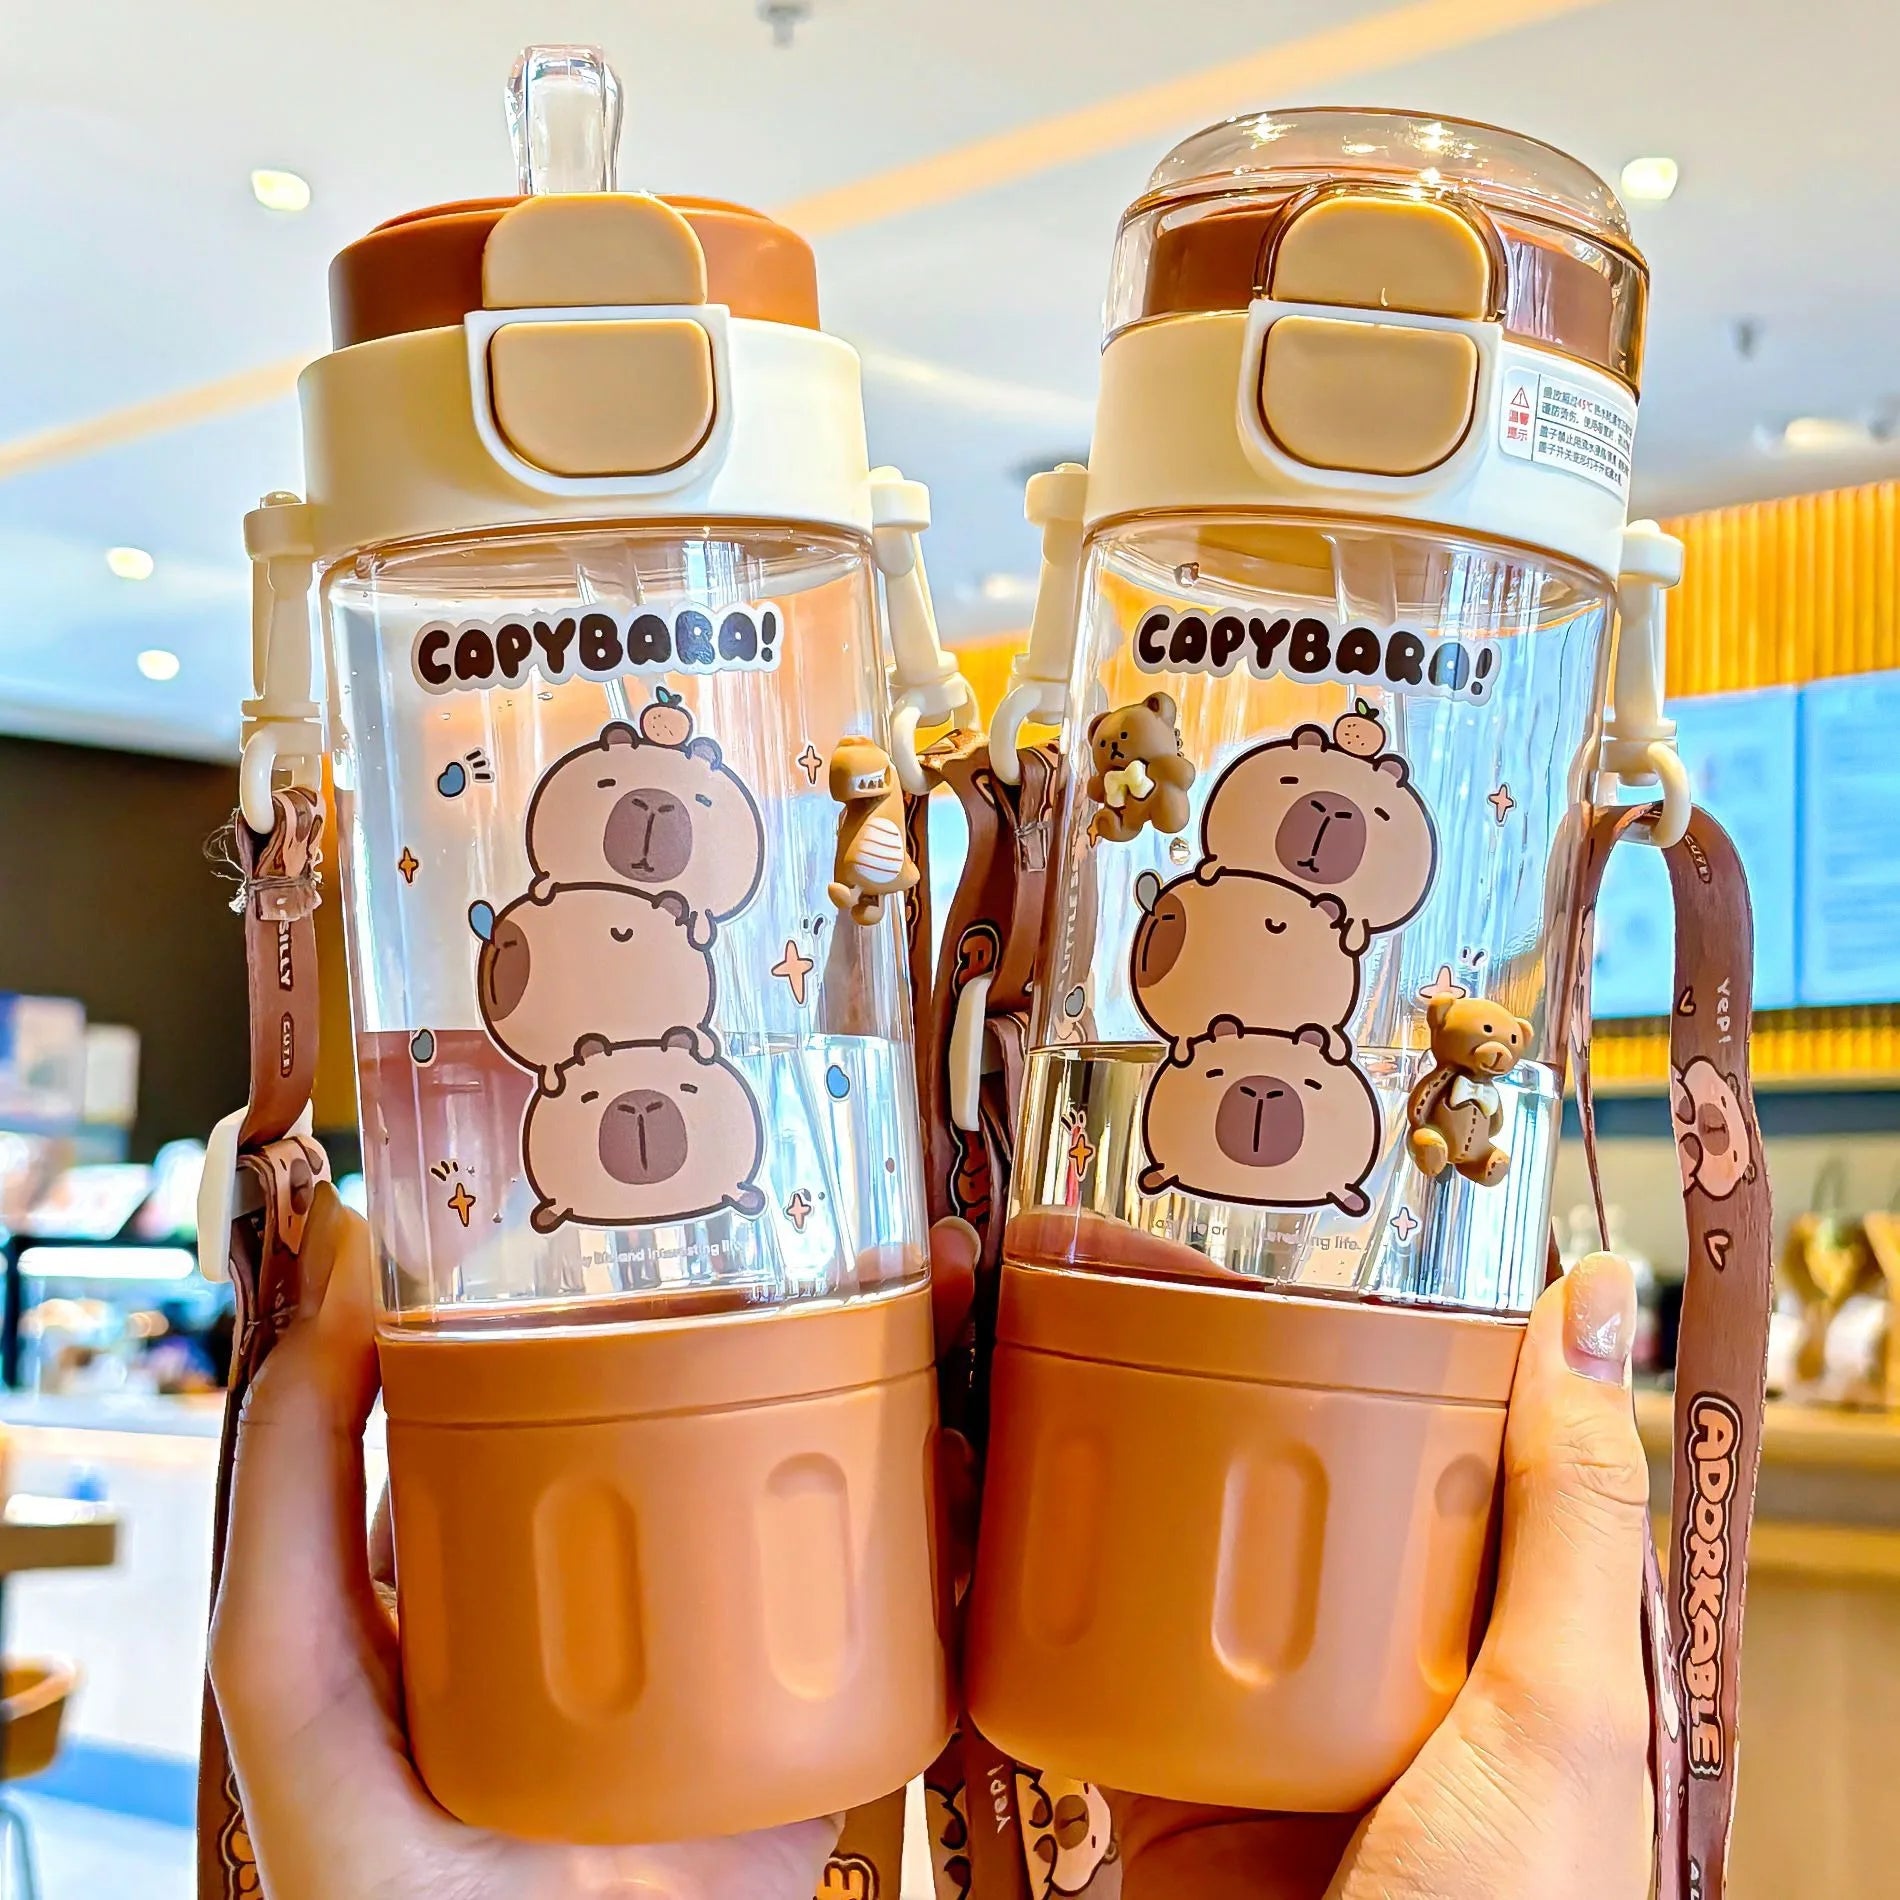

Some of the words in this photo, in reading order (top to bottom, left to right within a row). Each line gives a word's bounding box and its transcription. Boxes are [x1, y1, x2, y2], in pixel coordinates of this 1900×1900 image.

[417, 609, 777, 685] CAPYBARA!
[1138, 613, 1493, 696] CAPYBARA!
[278, 919, 292, 987] SILLY
[281, 1018, 292, 1072] CUTE
[1684, 1401, 1739, 1768] ADORKABLE
